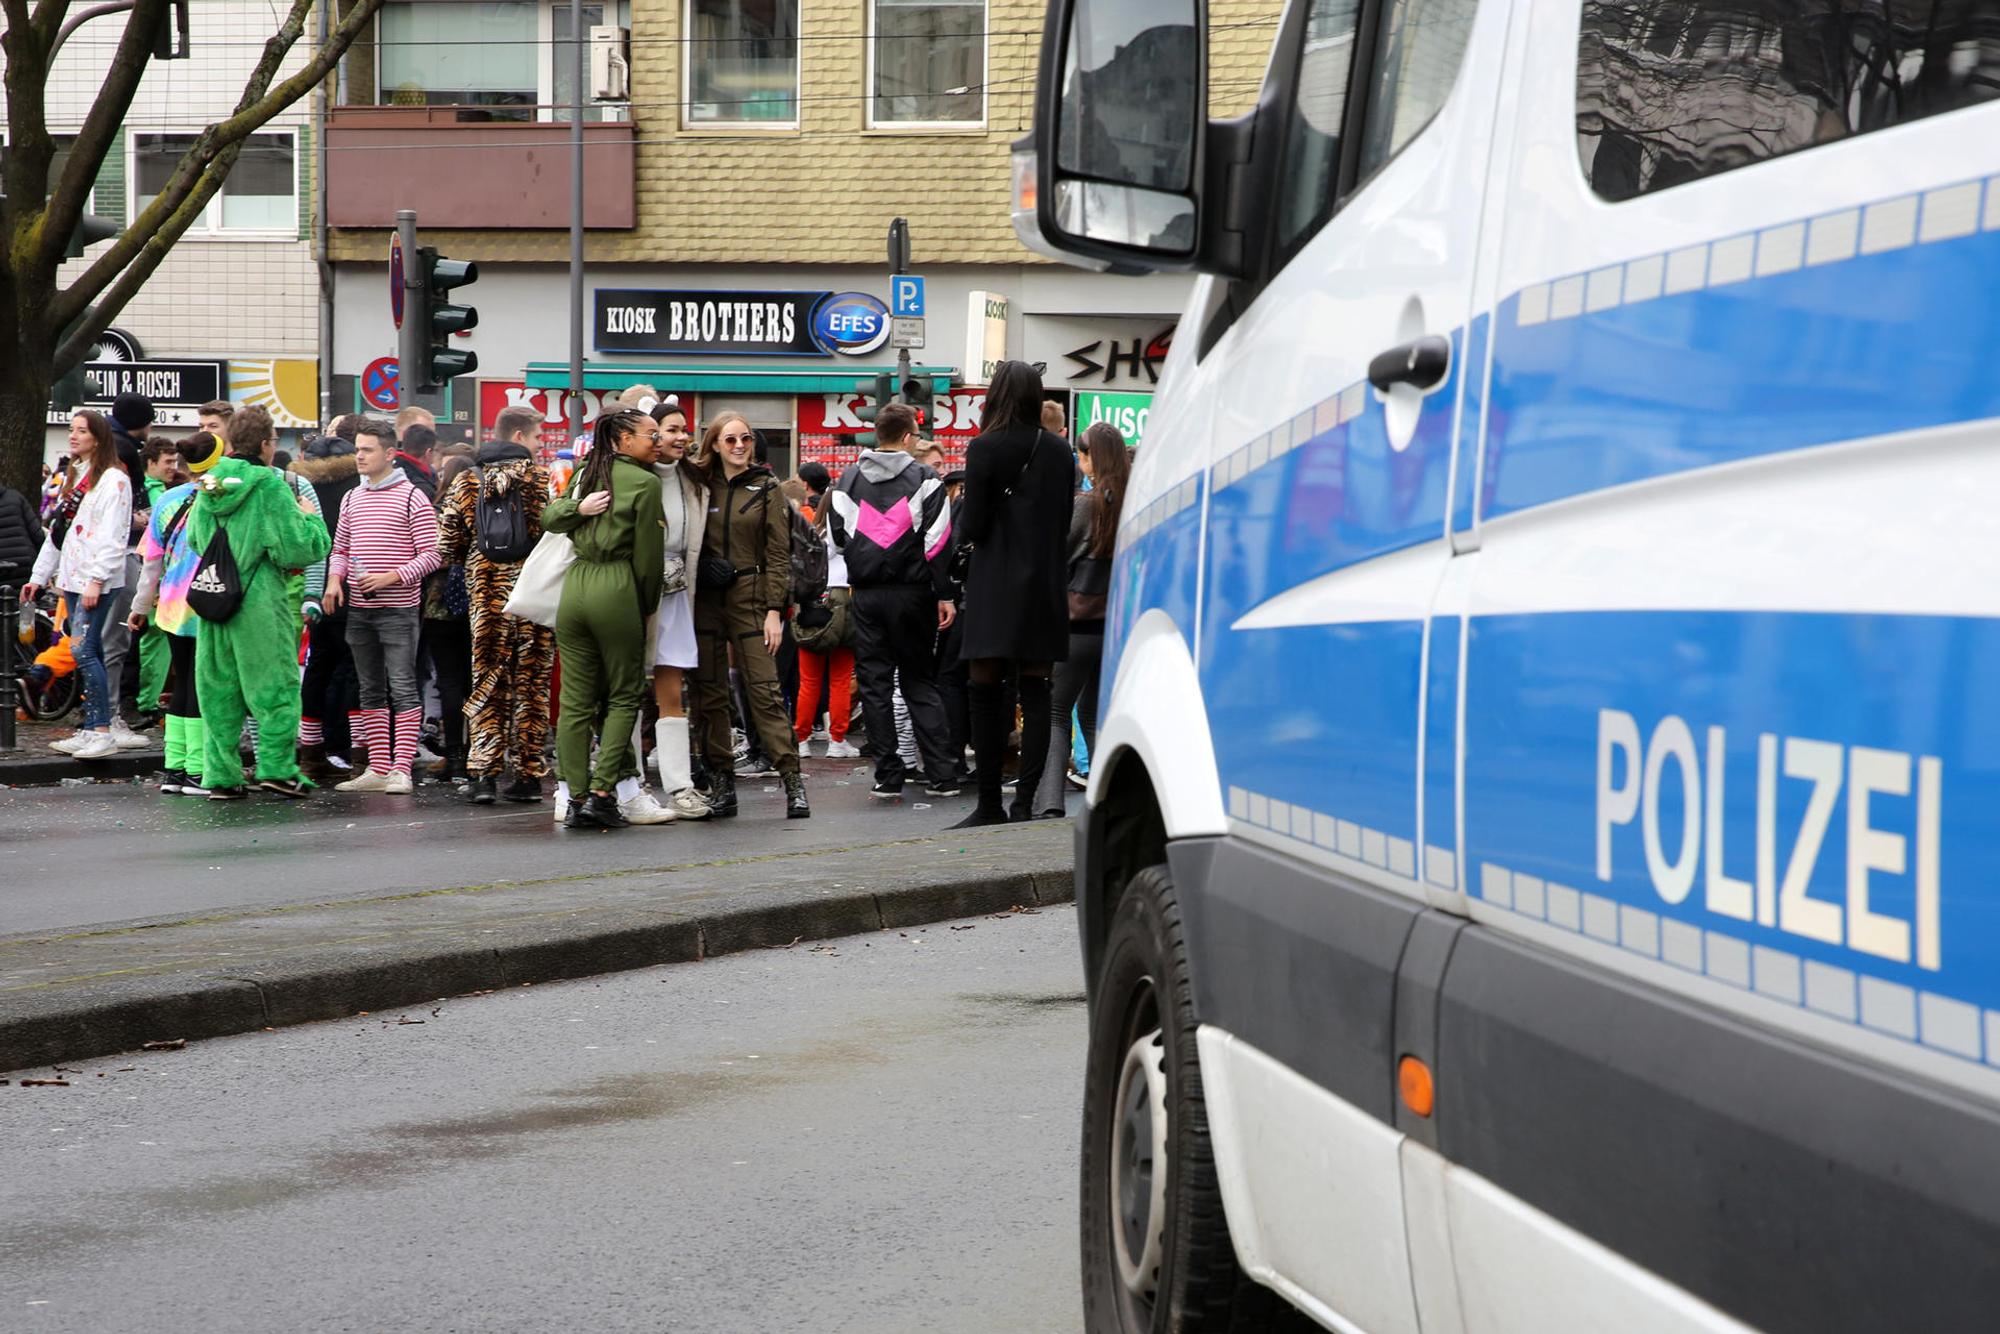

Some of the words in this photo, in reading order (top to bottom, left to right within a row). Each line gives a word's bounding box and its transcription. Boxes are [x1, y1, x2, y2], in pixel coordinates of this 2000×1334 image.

[899, 281, 917, 311] P
[606, 307, 656, 334] KIOSK
[669, 301, 796, 344] BROTHERS
[829, 313, 876, 333] EFES
[1596, 708, 1942, 972] POLIZEI
